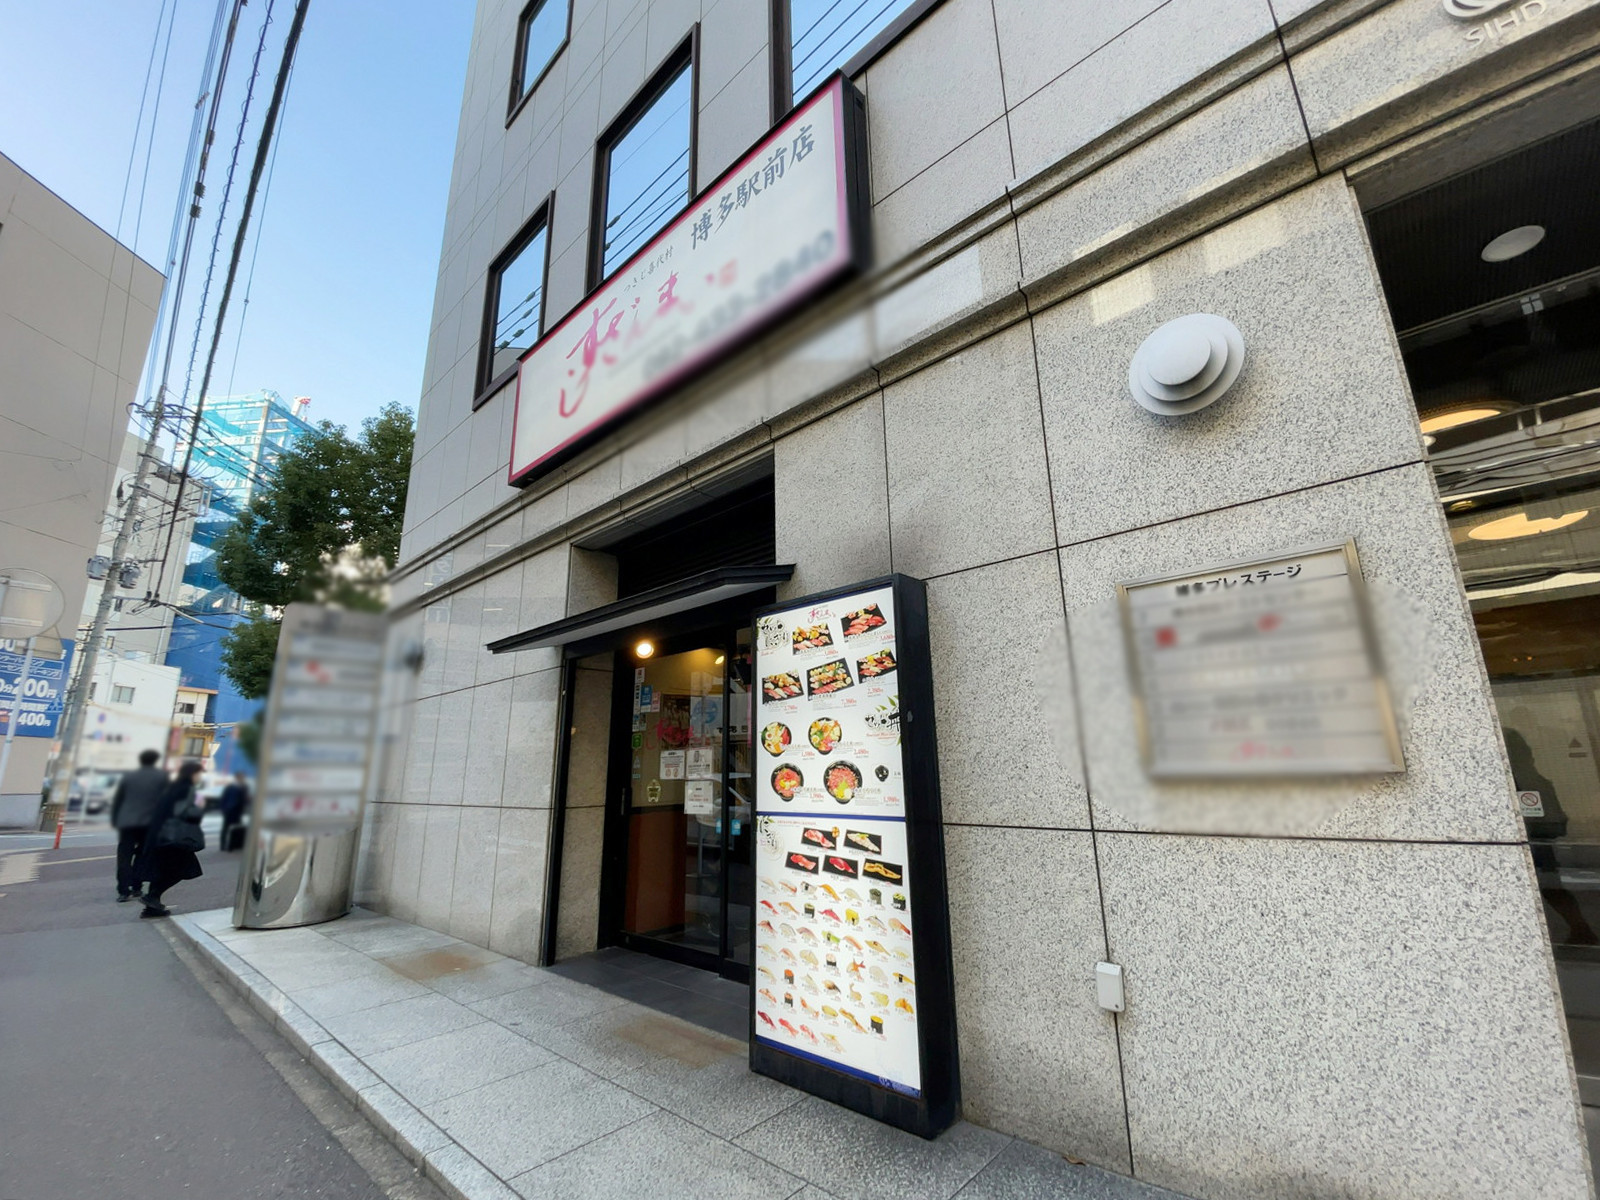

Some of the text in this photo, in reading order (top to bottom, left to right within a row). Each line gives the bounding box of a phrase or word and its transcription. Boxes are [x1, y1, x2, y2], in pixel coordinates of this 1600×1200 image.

[690, 123, 816, 250] 博多駅前店
[623, 245, 673, 294] つきじ喜代村
[1175, 563, 1302, 597] 多プレステージ
